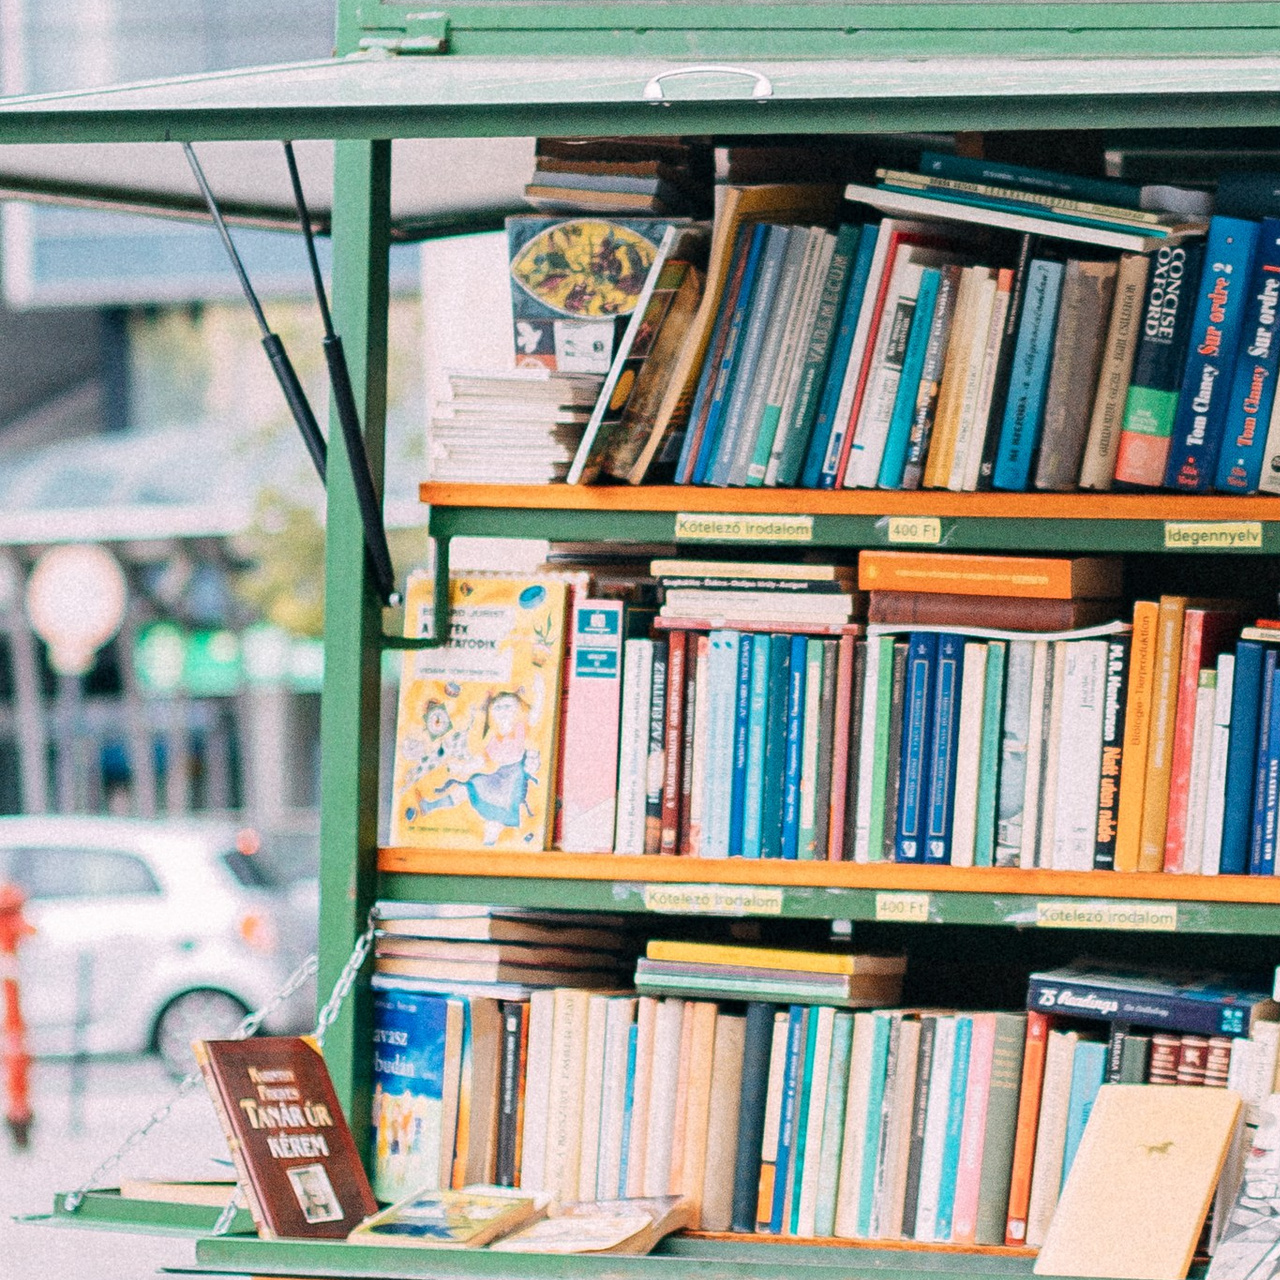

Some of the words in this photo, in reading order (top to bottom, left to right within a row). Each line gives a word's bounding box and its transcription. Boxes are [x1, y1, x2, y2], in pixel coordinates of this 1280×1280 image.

[1213, 261, 1232, 274] 2
[1145, 246, 1174, 338] OXFORD
[1160, 247, 1186, 339] CONCISE
[1205, 276, 1229, 323] ordre
[1254, 277, 1279, 325] ordre
[1198, 324, 1221, 356] Sur
[1248, 326, 1272, 358] Sur
[1191, 363, 1219, 414] Clancy
[1243, 364, 1269, 414] Clancy
[1186, 414, 1206, 447] Tom
[1237, 416, 1255, 447] Tom
[745, 522, 809, 535] irodalom
[893, 524, 918, 537] 400
[921, 524, 937, 538] Ft
[1167, 527, 1260, 546] Idegennyelv
[1133, 615, 1152, 694] Tierproduktion
[1130, 700, 1145, 745] Biologie
[1103, 746, 1118, 775] Natt
[1100, 778, 1114, 807] uten
[1268, 759, 1277, 806] NYELVTAN
[881, 900, 906, 914] 400
[910, 900, 925, 915] Ft
[1108, 909, 1173, 924] irodalom
[1038, 986, 1055, 1005] 75
[1058, 988, 1118, 1015] Readings
[303, 1100, 333, 1128] ÚR
[267, 1131, 330, 1158] KÉREM
